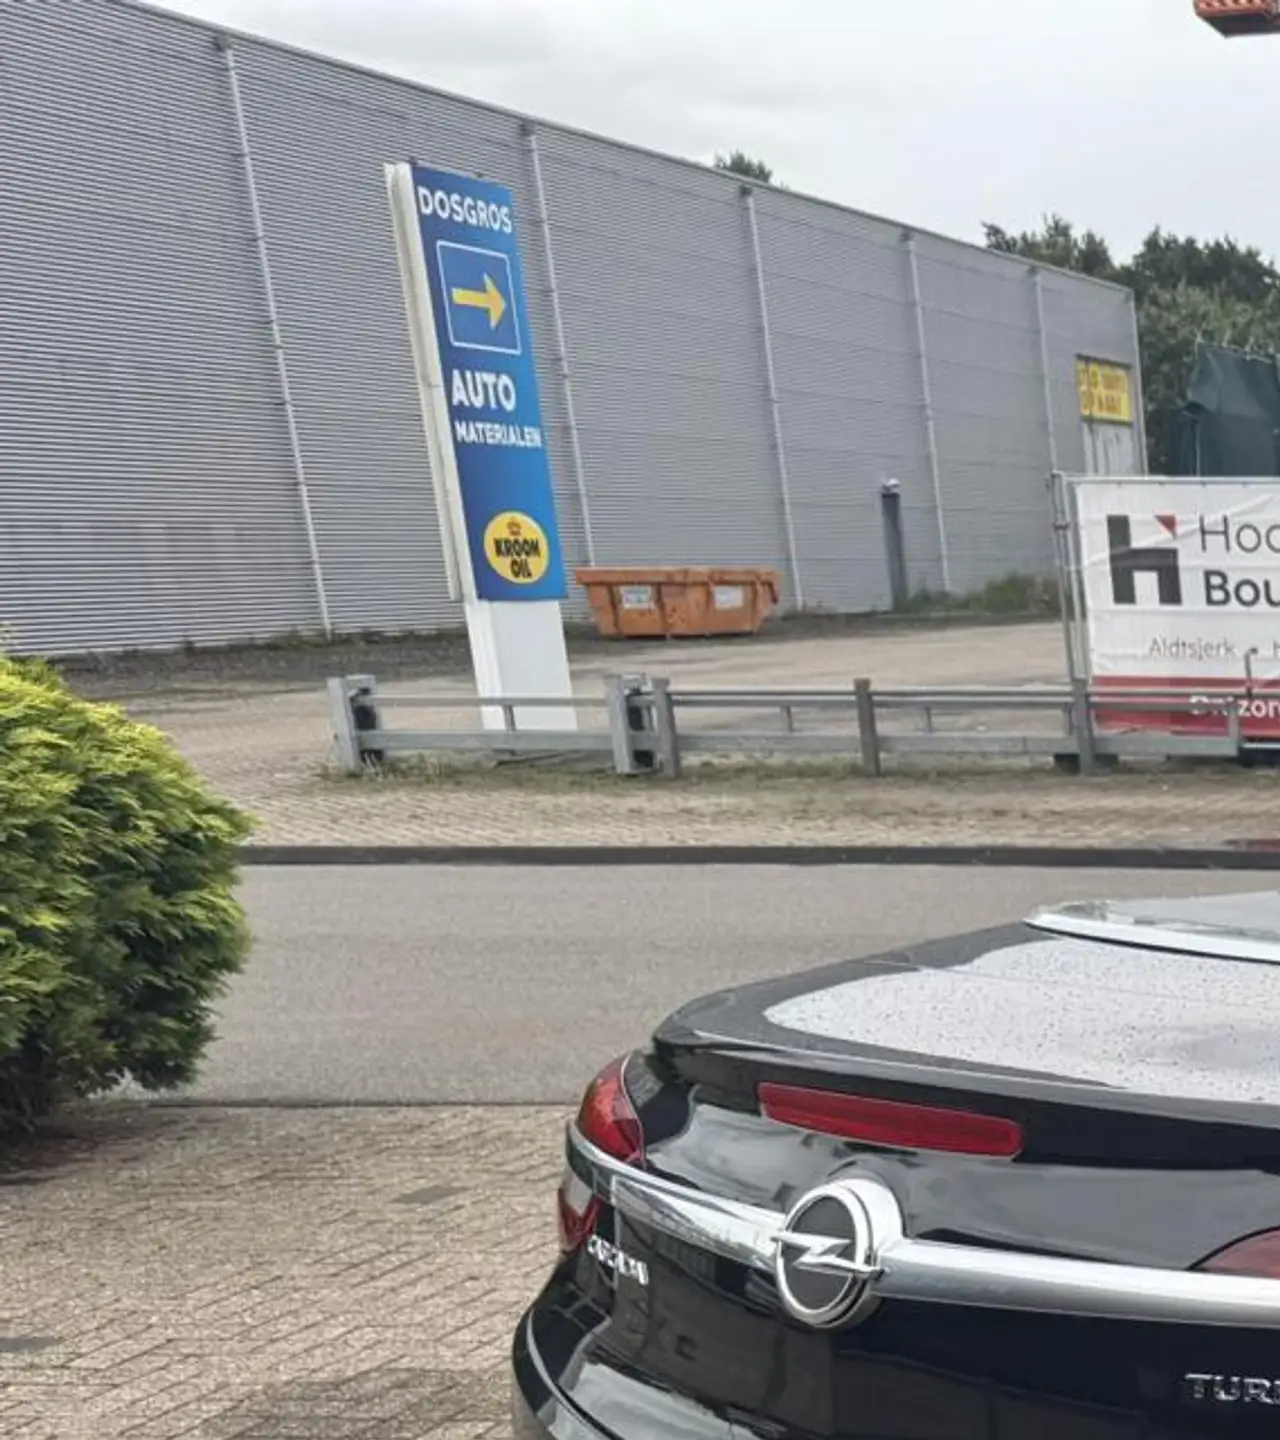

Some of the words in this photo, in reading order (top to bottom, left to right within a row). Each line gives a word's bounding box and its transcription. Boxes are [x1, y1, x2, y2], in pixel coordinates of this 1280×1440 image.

[417, 184, 513, 235] DOSGROS
[451, 369, 516, 412] AUTO
[455, 421, 542, 448] MATERIALEN
[509, 557, 533, 579] OIL
[1149, 637, 1236, 660] Aldtsjerk
